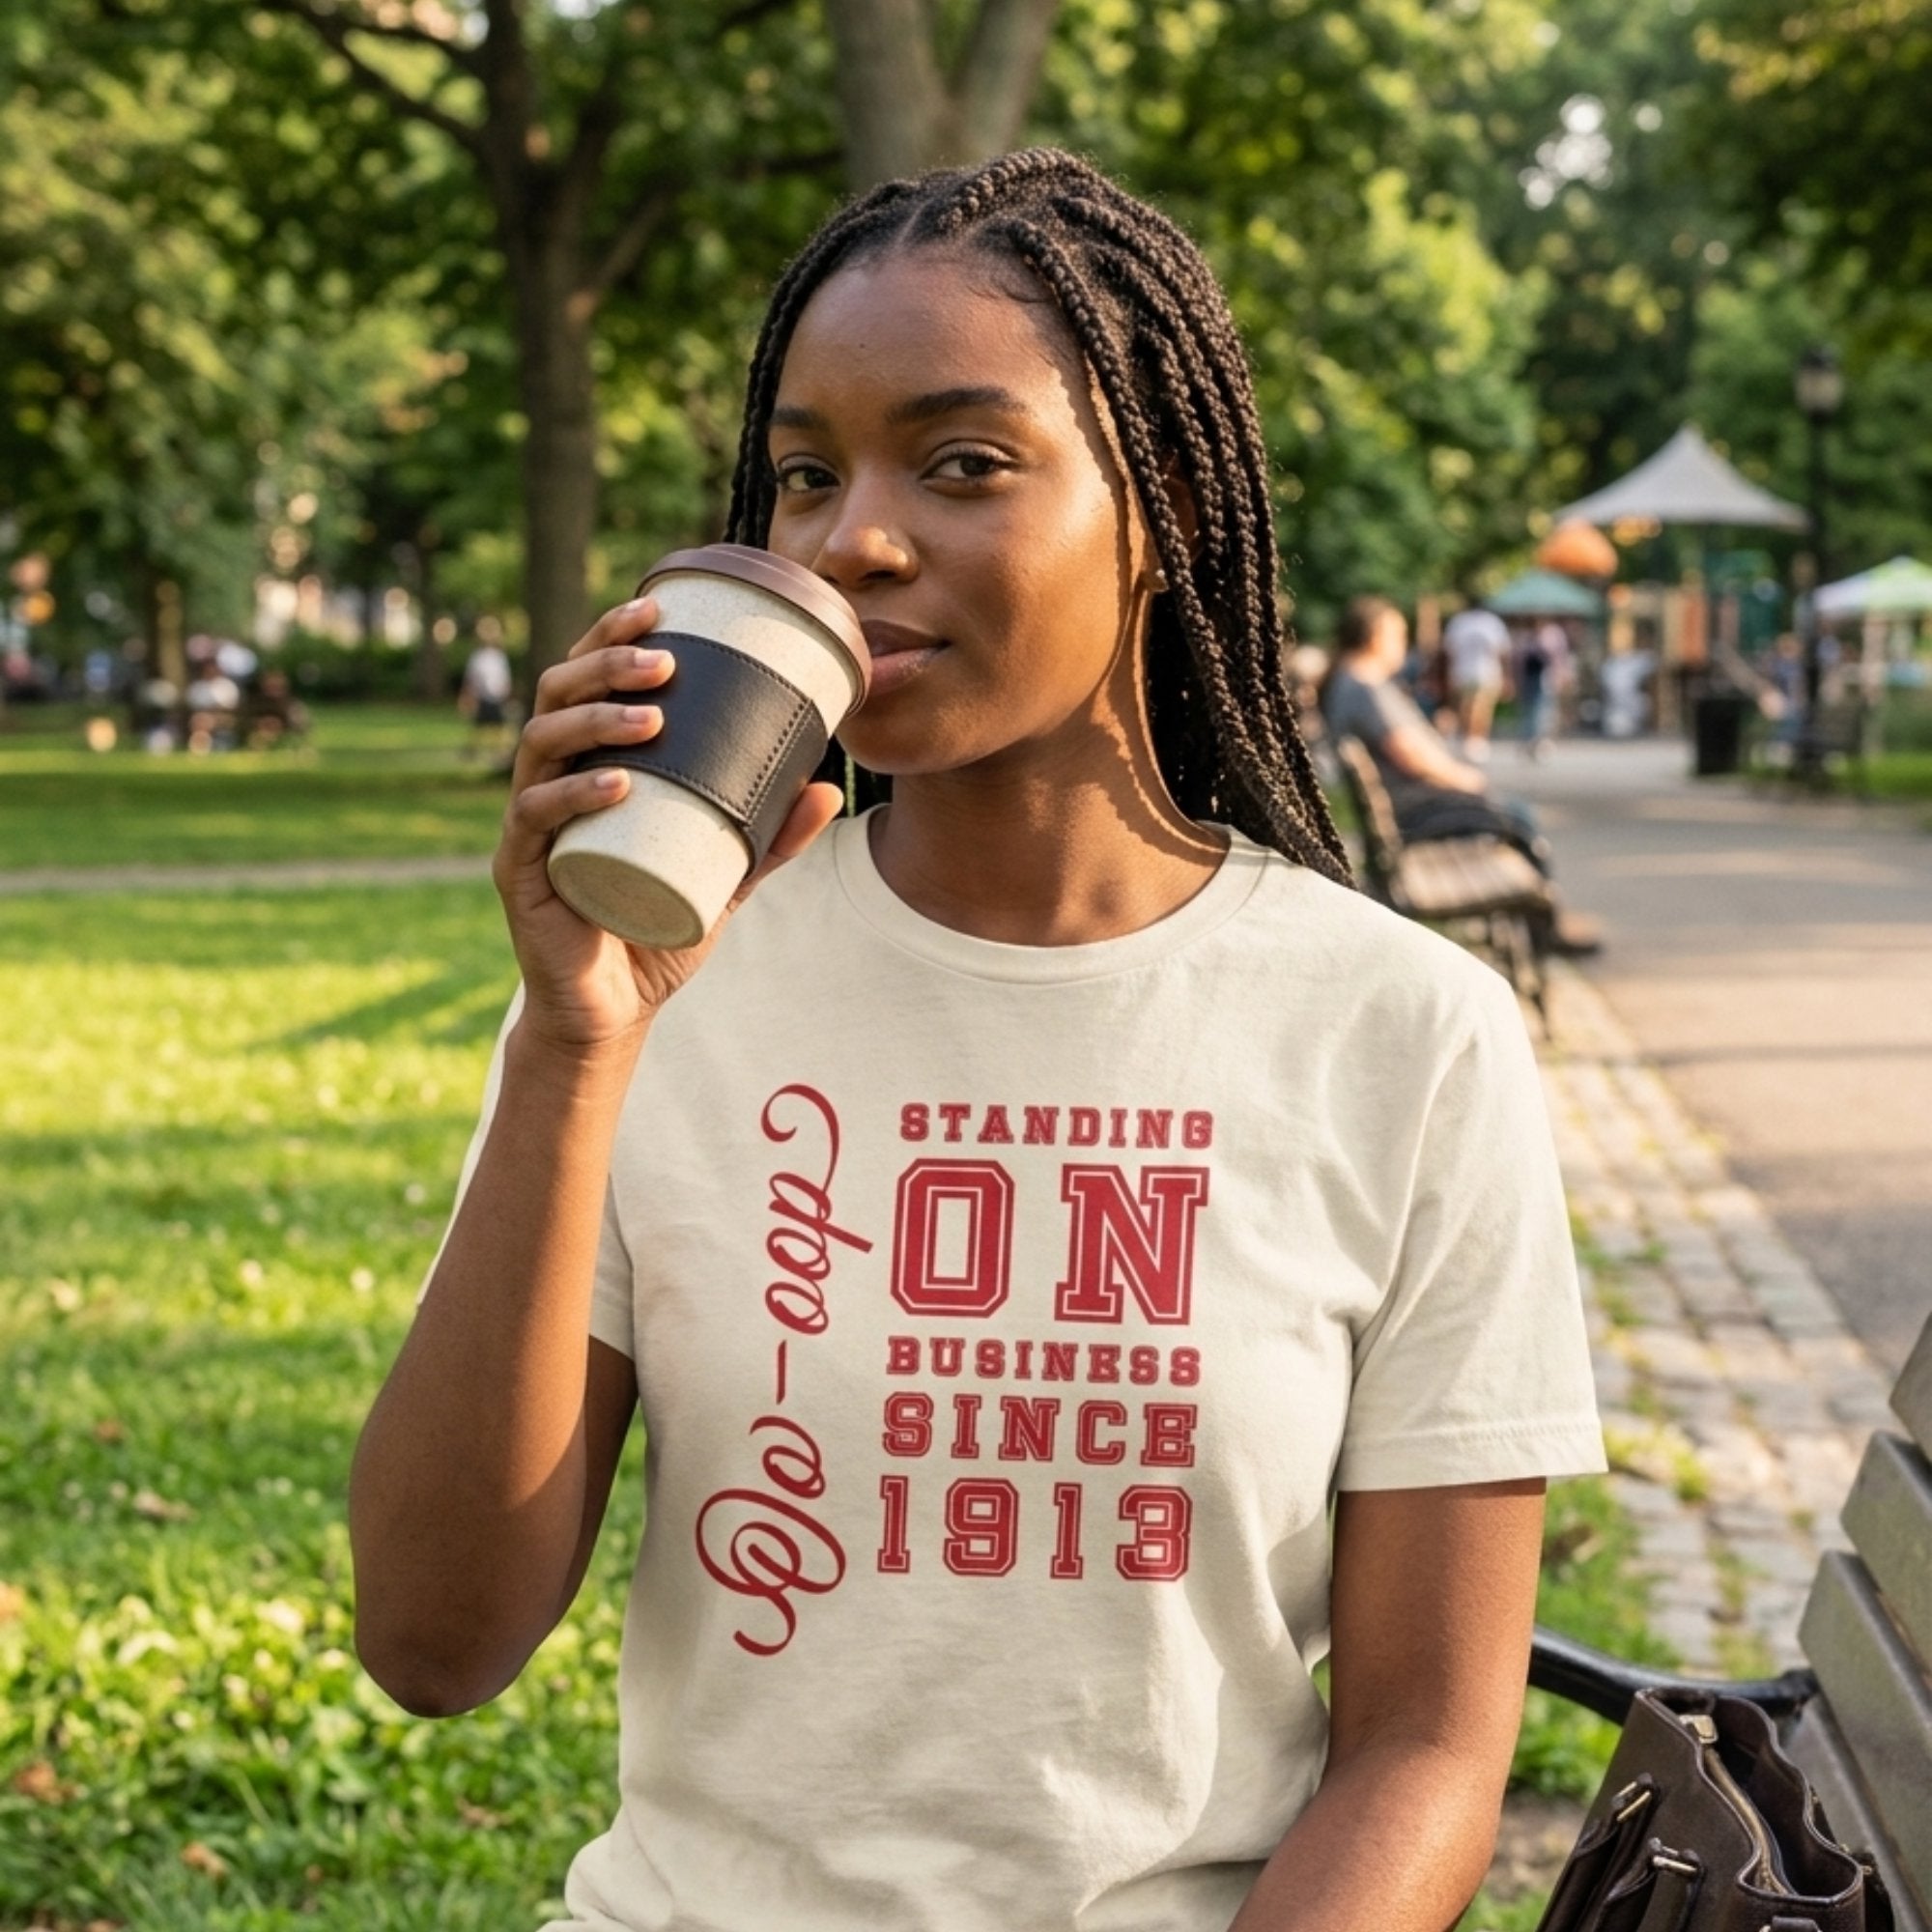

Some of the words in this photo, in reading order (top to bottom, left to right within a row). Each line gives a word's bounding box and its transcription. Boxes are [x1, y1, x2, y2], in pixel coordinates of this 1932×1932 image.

[900, 1103, 1213, 1150] STANDING
[890, 1157, 1209, 1325] ON
[887, 1336, 1201, 1387] BUSINESS
[882, 1392, 1198, 1467] SINCE
[877, 1475, 1192, 1582] 1913
